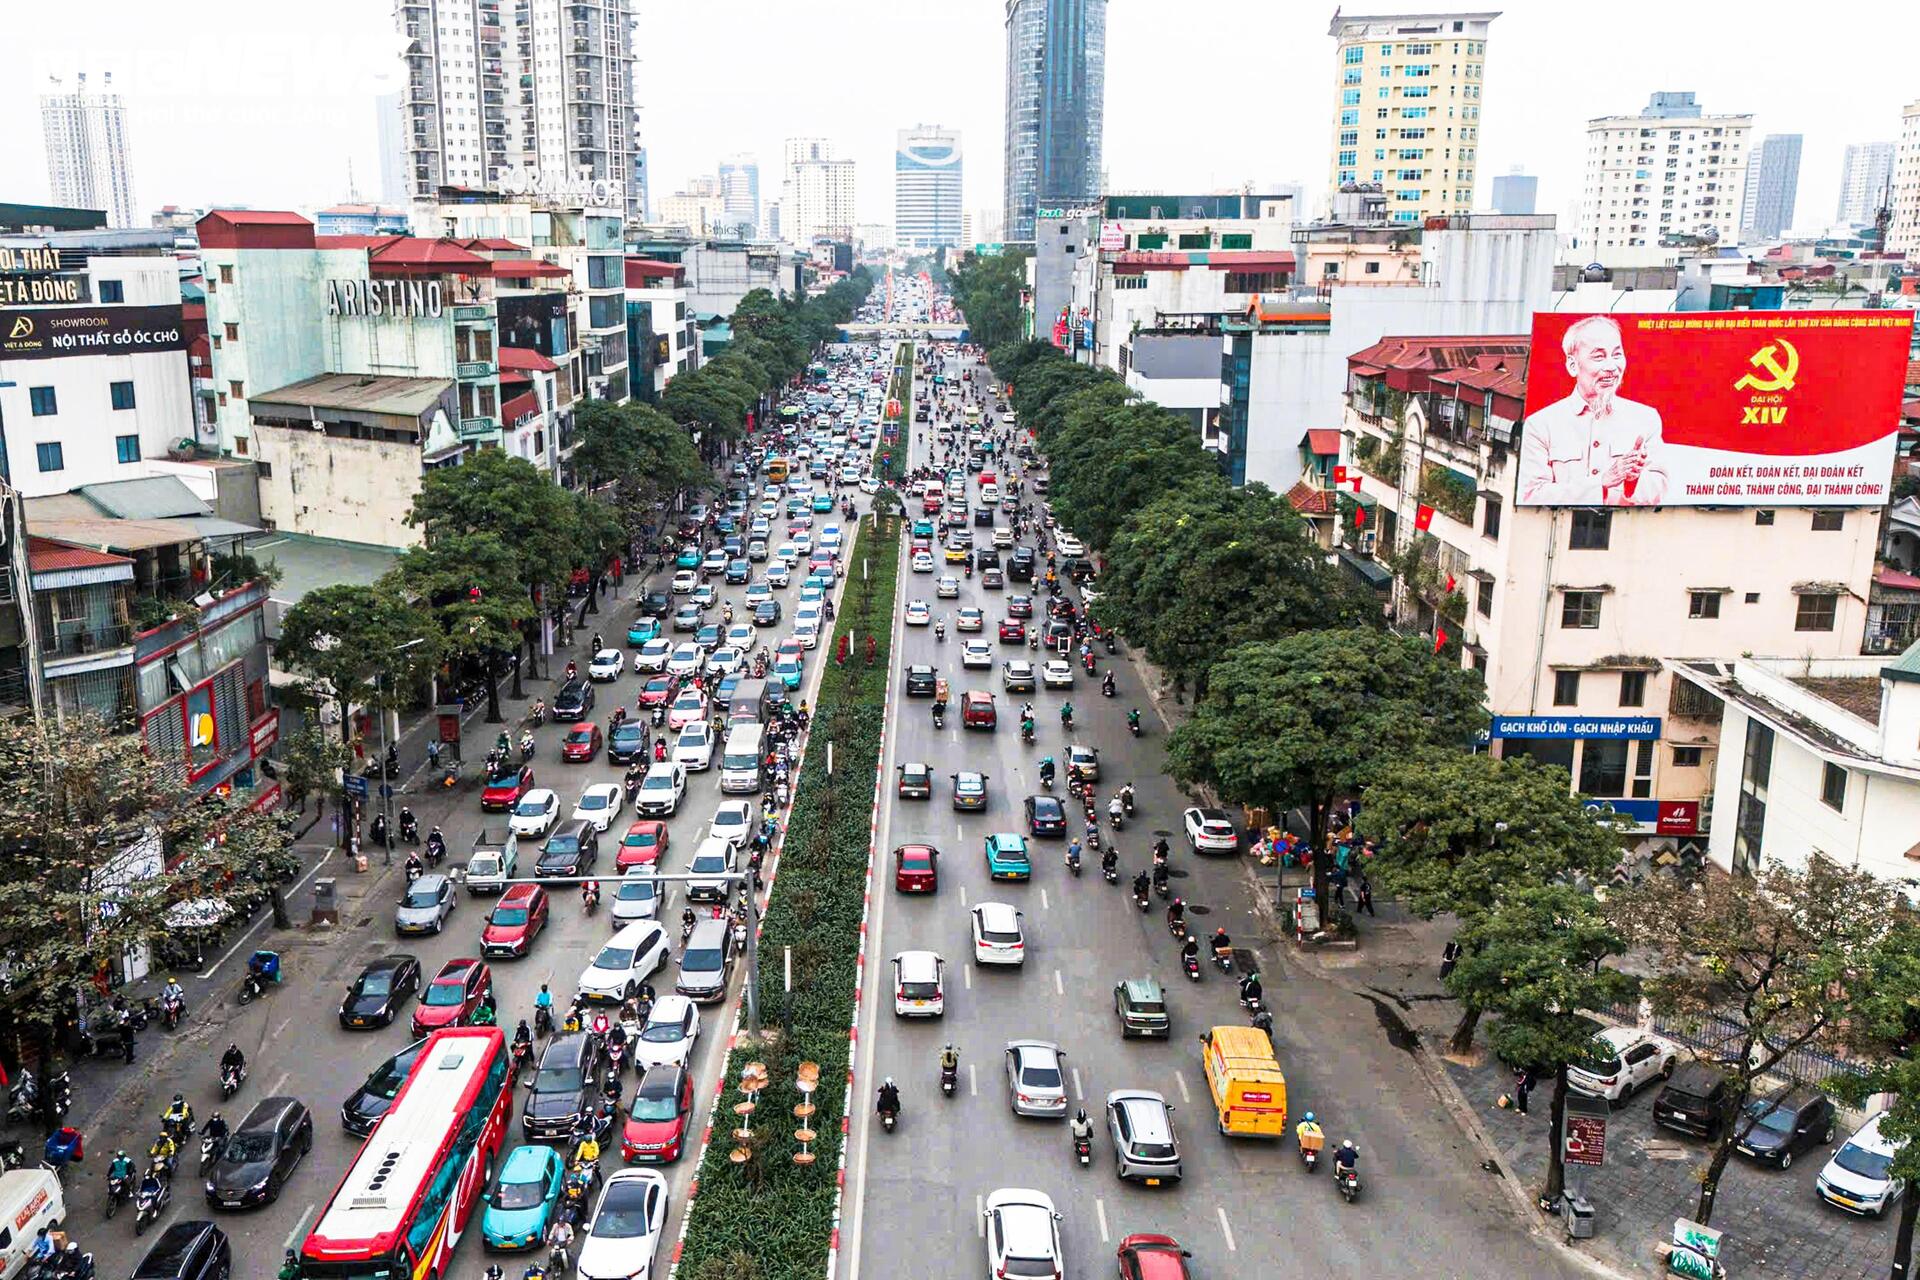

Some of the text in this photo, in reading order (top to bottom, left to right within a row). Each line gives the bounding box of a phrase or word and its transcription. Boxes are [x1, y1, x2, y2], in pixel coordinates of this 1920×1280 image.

[32, 275, 77, 301] ĐÔNG
[327, 279, 443, 318] ARISTINO
[50, 317, 109, 328] SHOWROOM
[52, 333, 77, 349] NỘI
[78, 330, 110, 346] THẤT
[153, 328, 179, 343] CHÓ
[1741, 406, 1788, 424] XIV
[1709, 463, 1864, 480] ĐOÀN KẾT, ĐOÀN KẾT, ĐẠI ĐOÀN KẾT
[1686, 482, 1883, 497] THÀNH CÔNG, THÀNH CÔNG, ĐẠI THÀNH CÔNG!
[1500, 722, 1525, 734] GẠCH
[1573, 722, 1599, 735] GẠCH
[1600, 721, 1626, 736] NHẬP
